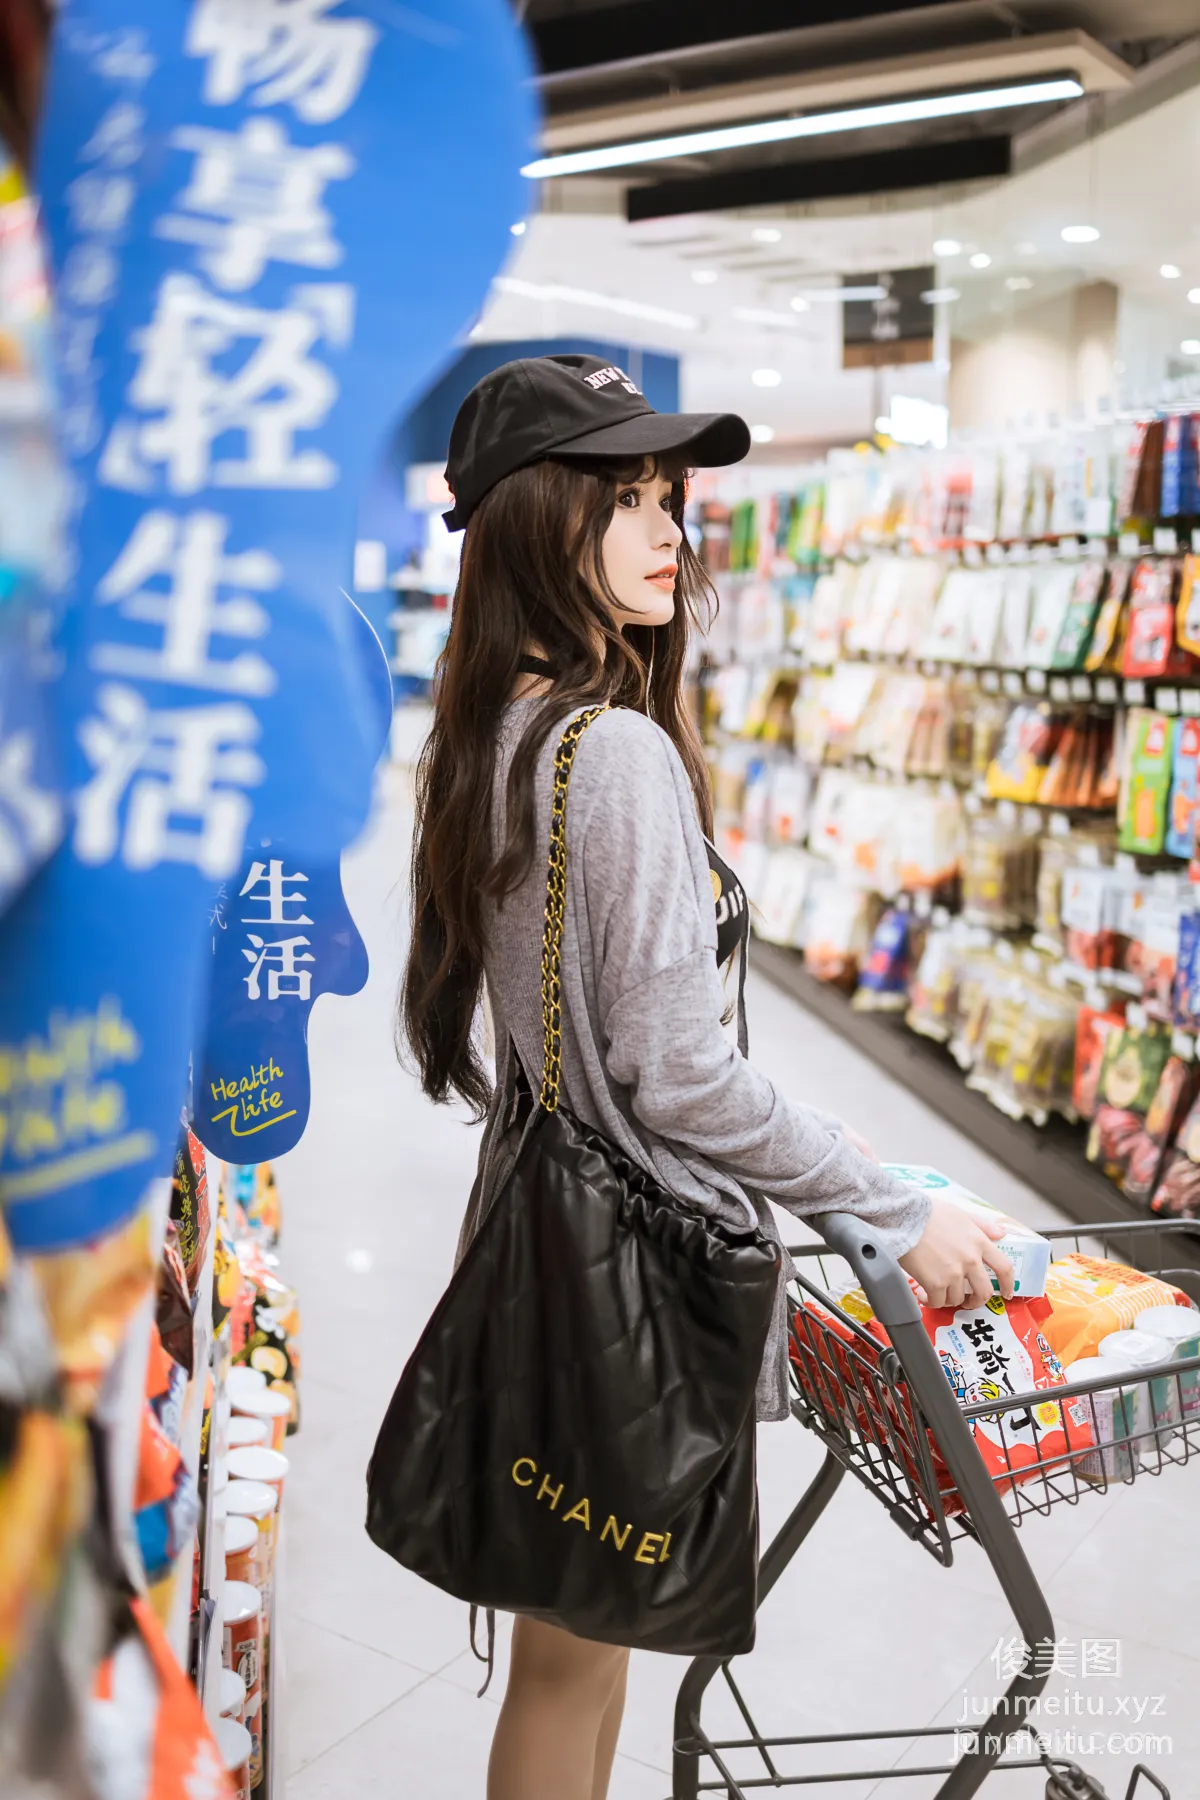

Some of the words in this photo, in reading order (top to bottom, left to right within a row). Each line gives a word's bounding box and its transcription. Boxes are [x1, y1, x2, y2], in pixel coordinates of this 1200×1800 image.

[583, 367, 620, 390] NEW
[239, 859, 316, 1001] 生活
[210, 1058, 284, 1101] Health
[961, 1318, 1042, 1431] 出前一丁
[512, 1457, 672, 1564] CHANEL
